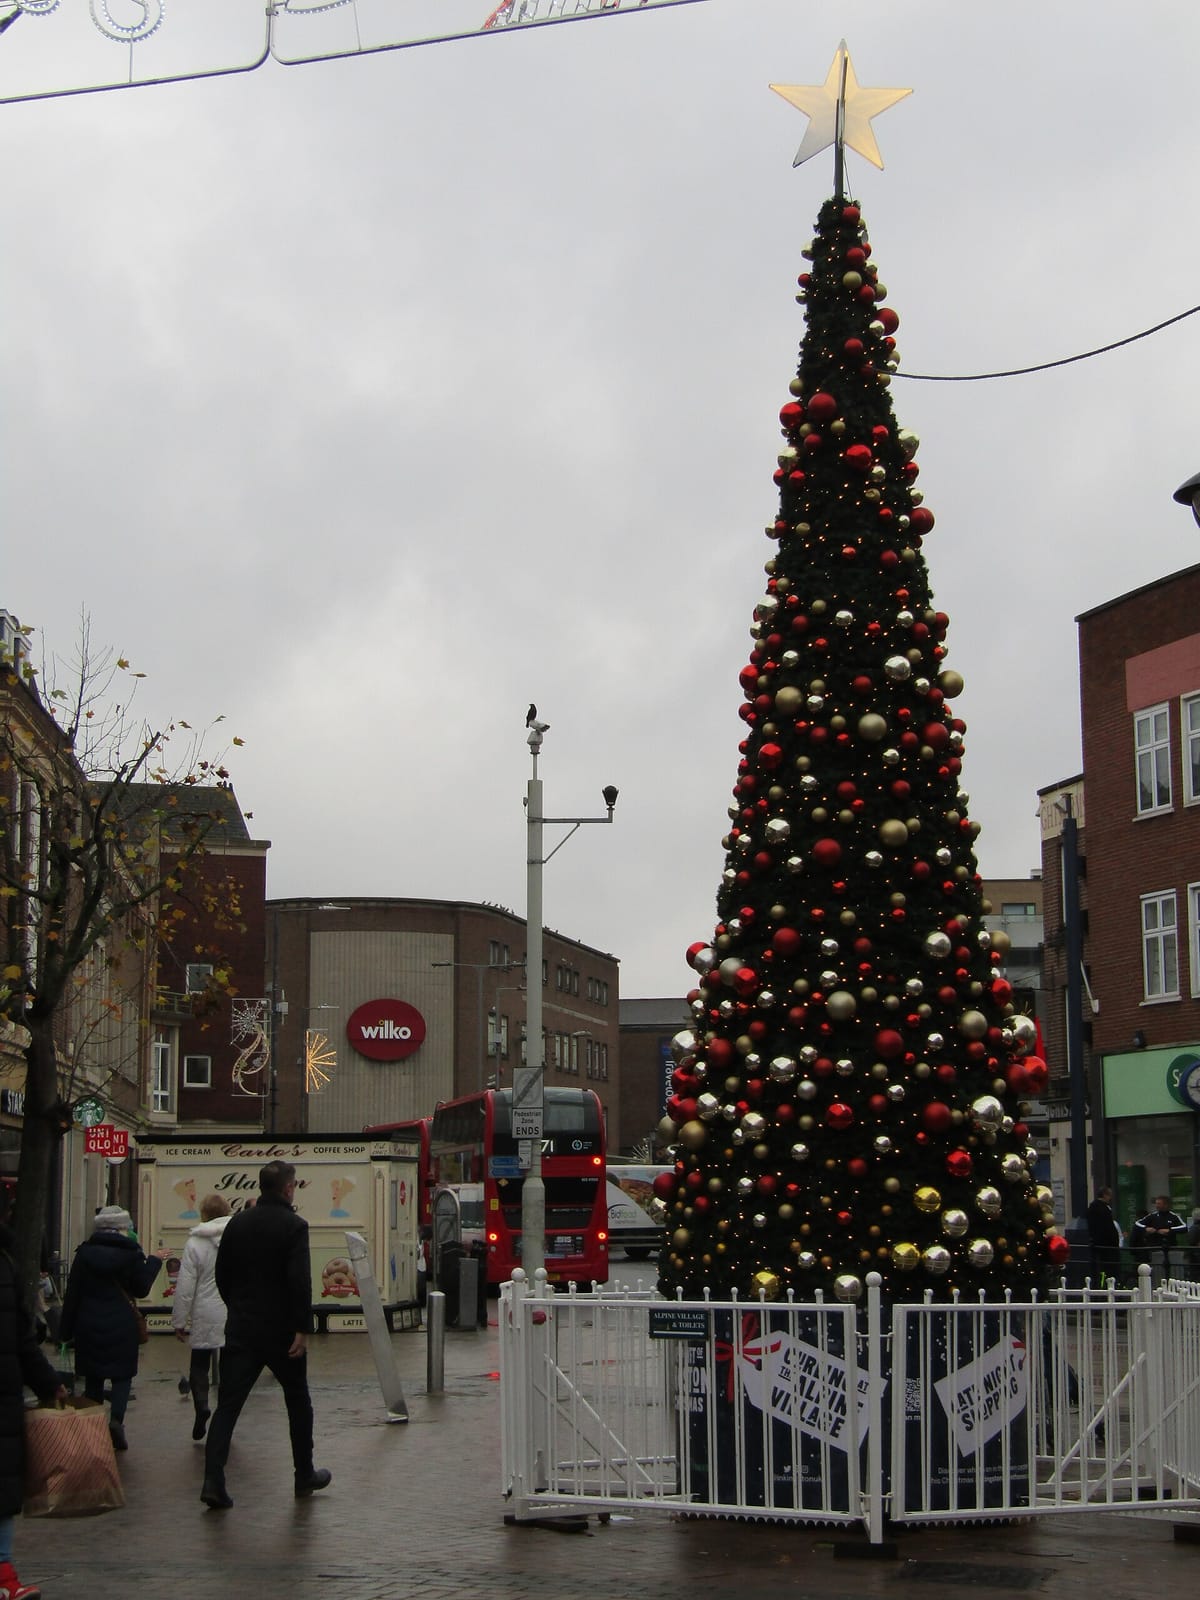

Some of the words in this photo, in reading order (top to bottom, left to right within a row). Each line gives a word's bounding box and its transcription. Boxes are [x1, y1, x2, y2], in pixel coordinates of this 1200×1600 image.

[361, 1019, 411, 1039] wilko
[89, 1128, 109, 1138] UNI
[516, 1126, 540, 1135] ENDS
[89, 1139, 111, 1151] QLO
[112, 1134, 124, 1144] NI
[313, 1146, 341, 1154] COFFEE
[343, 1146, 366, 1154] SHOP
[214, 1172, 312, 1190] Itan
[677, 1312, 705, 1320] VILLAGE
[679, 1321, 705, 1329] TOILETS
[779, 1366, 794, 1379] TH
[784, 1347, 848, 1393] CURN
[983, 1354, 1016, 1394] NIGT
[961, 1376, 1018, 1432] SHPPG
